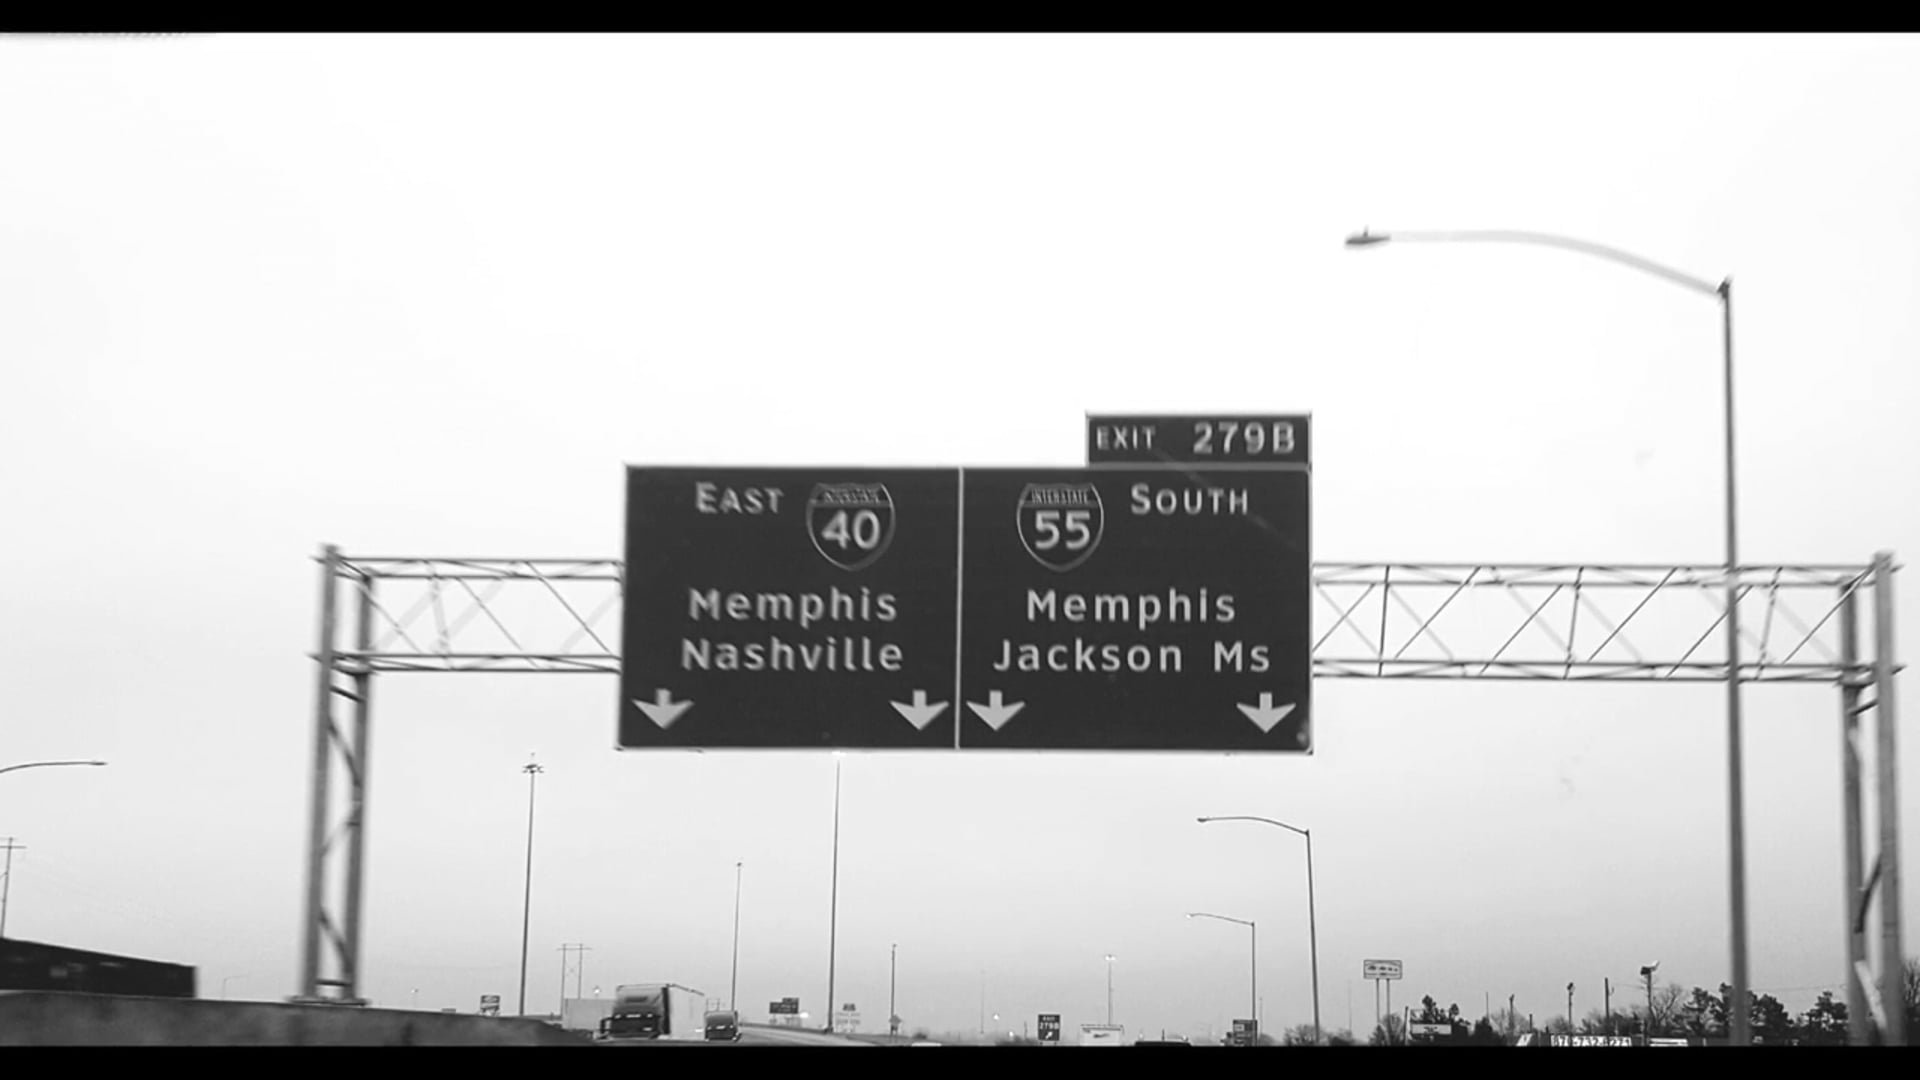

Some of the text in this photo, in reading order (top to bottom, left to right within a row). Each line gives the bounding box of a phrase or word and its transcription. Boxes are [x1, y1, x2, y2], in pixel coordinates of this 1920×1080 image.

[1096, 420, 1295, 454] EXIT 279B
[695, 482, 783, 514] EAST
[1130, 482, 1248, 515] SOUTH
[820, 509, 882, 550] 40
[1034, 509, 1091, 550] 55
[689, 586, 898, 629] Memphis
[1027, 587, 1236, 629] Memphis
[682, 637, 903, 672] Nashville
[993, 637, 1270, 673] Jackson Ms
